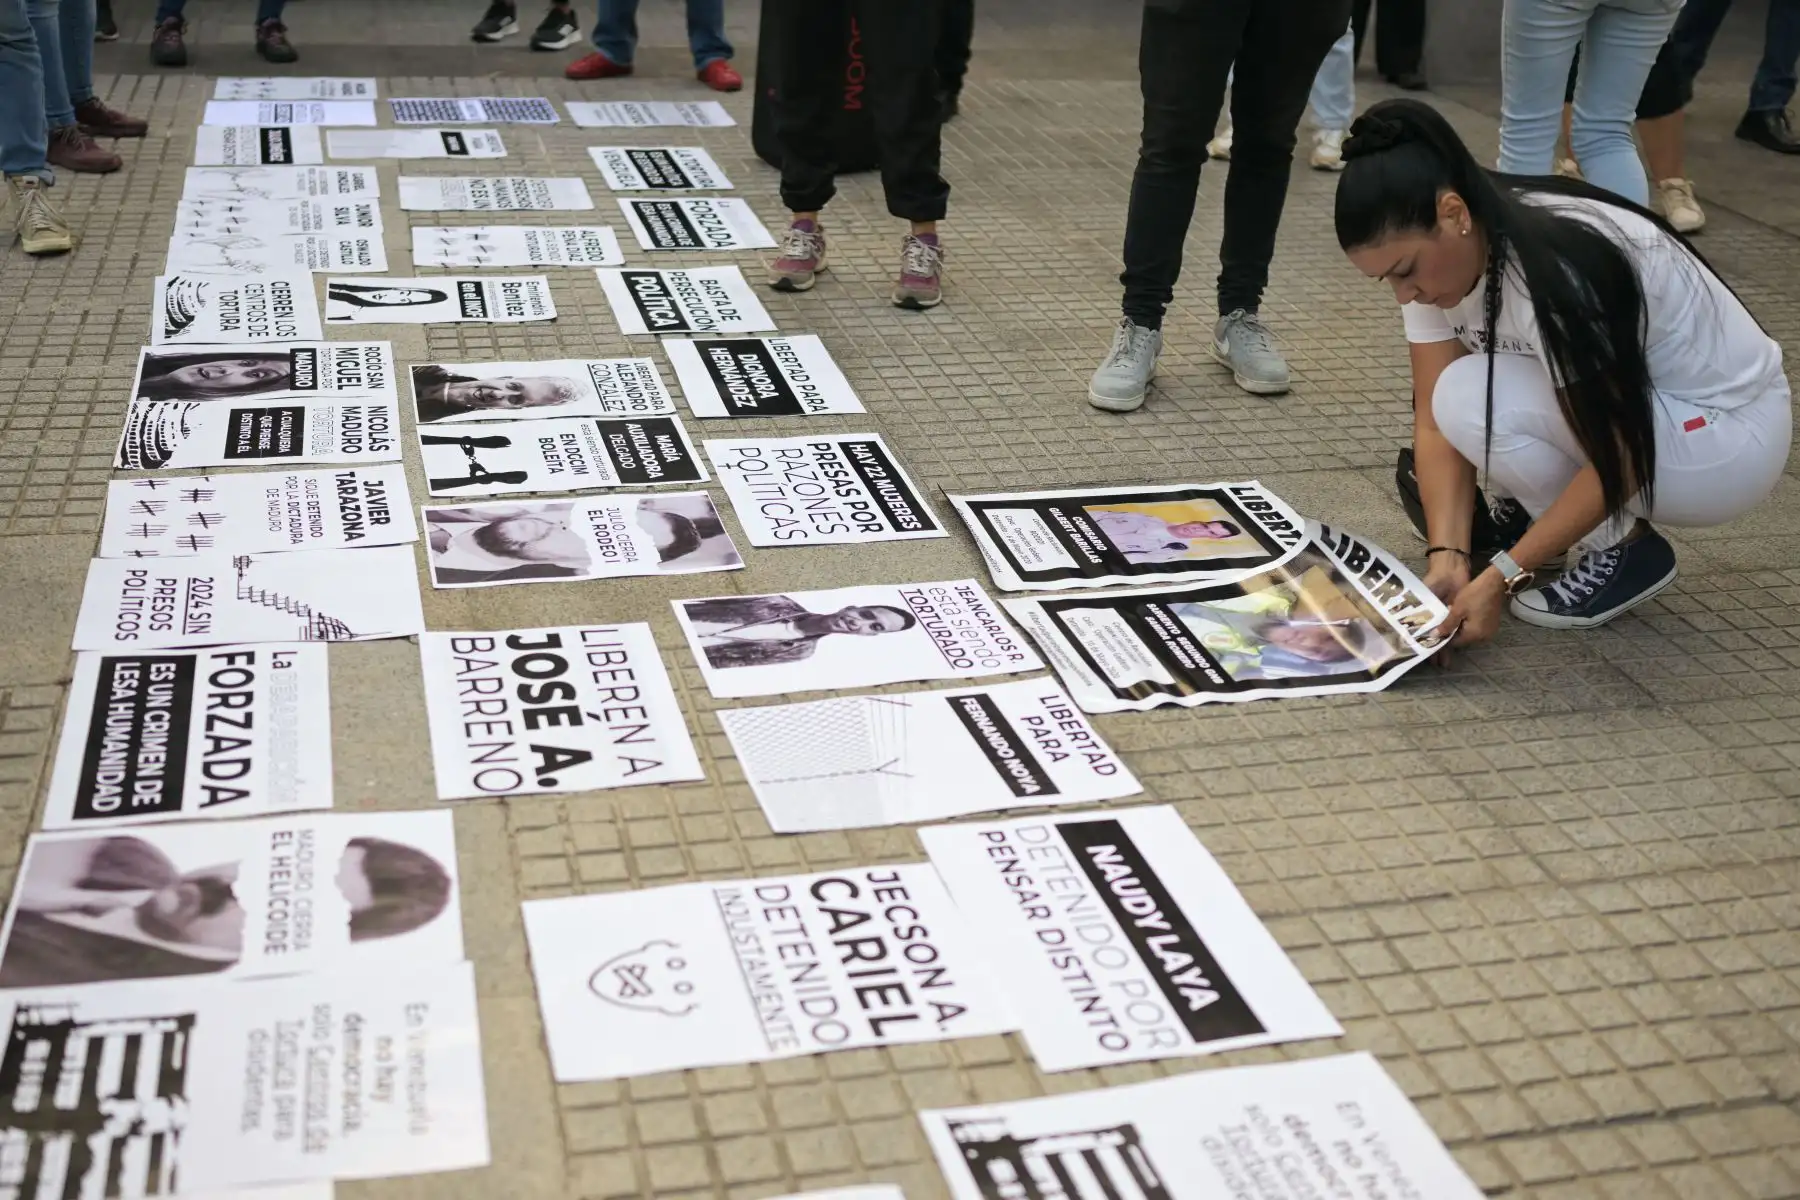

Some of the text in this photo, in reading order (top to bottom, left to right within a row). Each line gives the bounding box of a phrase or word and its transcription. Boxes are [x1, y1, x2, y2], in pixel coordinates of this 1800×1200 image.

[469, 179, 492, 209] NO ES UN
[601, 150, 640, 188] VENEZUELA
[682, 158, 717, 188] TORTURA
[334, 207, 351, 226] SILVA
[685, 200, 738, 248] FORZADA
[339, 240, 355, 265] CASTILLO
[356, 239, 372, 266] OSWALDO
[579, 230, 605, 262] ALFREDO
[218, 290, 241, 332] TORTURA
[244, 283, 269, 338] CENTROS DE
[271, 281, 297, 337] CIERREN LOS
[629, 276, 681, 328] POLÍTICA
[667, 271, 721, 331] PERSECUCIÓN
[699, 279, 742, 322] BASTA DE
[294, 351, 314, 388] MADURO
[335, 347, 362, 391] MIGUEL
[363, 346, 388, 390] ROCÍO SAN
[590, 363, 627, 412] GONZÁLEZ
[614, 362, 650, 412] ALEJANDRO
[633, 362, 667, 411] LIBERTAD PARA
[707, 347, 759, 409] HERNÁNDEZ
[737, 354, 781, 400] DIGNORA
[767, 338, 830, 413] LIBERTAD PARA
[239, 413, 256, 439] DISTINTO
[258, 415, 274, 450] QUE PIENSE
[278, 417, 294, 454] CUALQUIERA
[311, 406, 335, 457] TORTURA
[340, 406, 363, 455] MADURO
[367, 405, 396, 453] NICOLÁS
[560, 433, 579, 448] EN
[608, 433, 637, 469] DELGADO
[625, 423, 666, 479] AUXILIADORA
[654, 434, 683, 463] MARÍA
[537, 436, 567, 475] BOLEÍTA
[266, 488, 283, 532] DE MADURO
[285, 475, 304, 545] POR LA DICTADURA
[304, 478, 324, 538] SIGUE DETENIDO
[335, 471, 366, 542] TARAZONA
[363, 480, 391, 526] JAVIER
[727, 447, 809, 540] POLÍTICAS
[771, 448, 850, 535] RAZONES
[806, 442, 885, 534] PRESAS POR
[848, 443, 922, 529] HAY 22 MUJERES
[587, 510, 604, 522] EL
[591, 523, 619, 558] RODEO
[1048, 507, 1103, 564] GILBERT BARILLAS
[1072, 516, 1108, 551] COMISARIO
[615, 533, 640, 564] CIERRA
[114, 570, 150, 641] POLÍTICOS
[149, 578, 177, 632] PRESOS
[187, 577, 215, 635] 2024 SIN
[903, 588, 974, 669] TORTURADO
[928, 587, 969, 617] está
[951, 619, 1002, 669] siendo
[954, 585, 1018, 651] JEANCARLOS
[1007, 652, 1025, 664] R.
[271, 650, 299, 669] La
[1146, 603, 1181, 635] SARGENTO
[1176, 636, 1211, 669] SEGUNDO
[1165, 640, 1196, 669] ROMERO
[450, 636, 525, 793] BARRENO
[504, 632, 603, 789] JOSÉ A.
[579, 628, 665, 778] LIBEREN A
[959, 697, 1016, 758] FERNANDO
[91, 661, 143, 814] LESA HUMANIDAD
[131, 662, 177, 808] ES UN CRIMEN DE
[198, 650, 257, 810] FORZADA
[1019, 716, 1071, 763] PARA
[1039, 695, 1118, 776] LIBERTAD
[263, 830, 294, 957] EL HELICOIDE
[866, 871, 968, 1033] JECSON A.
[977, 829, 1132, 1053] PENSAR DISTINTO
[1014, 824, 1183, 1051] DETENIDO POR
[1084, 843, 1221, 1012] NAUDY LAYA
[717, 886, 803, 1053] INJUSTAMENTE
[754, 883, 851, 1045] DETENIDO
[809, 877, 921, 1038] CARIEL
[403, 1001, 430, 1029] En
[367, 1035, 399, 1104] no hay
